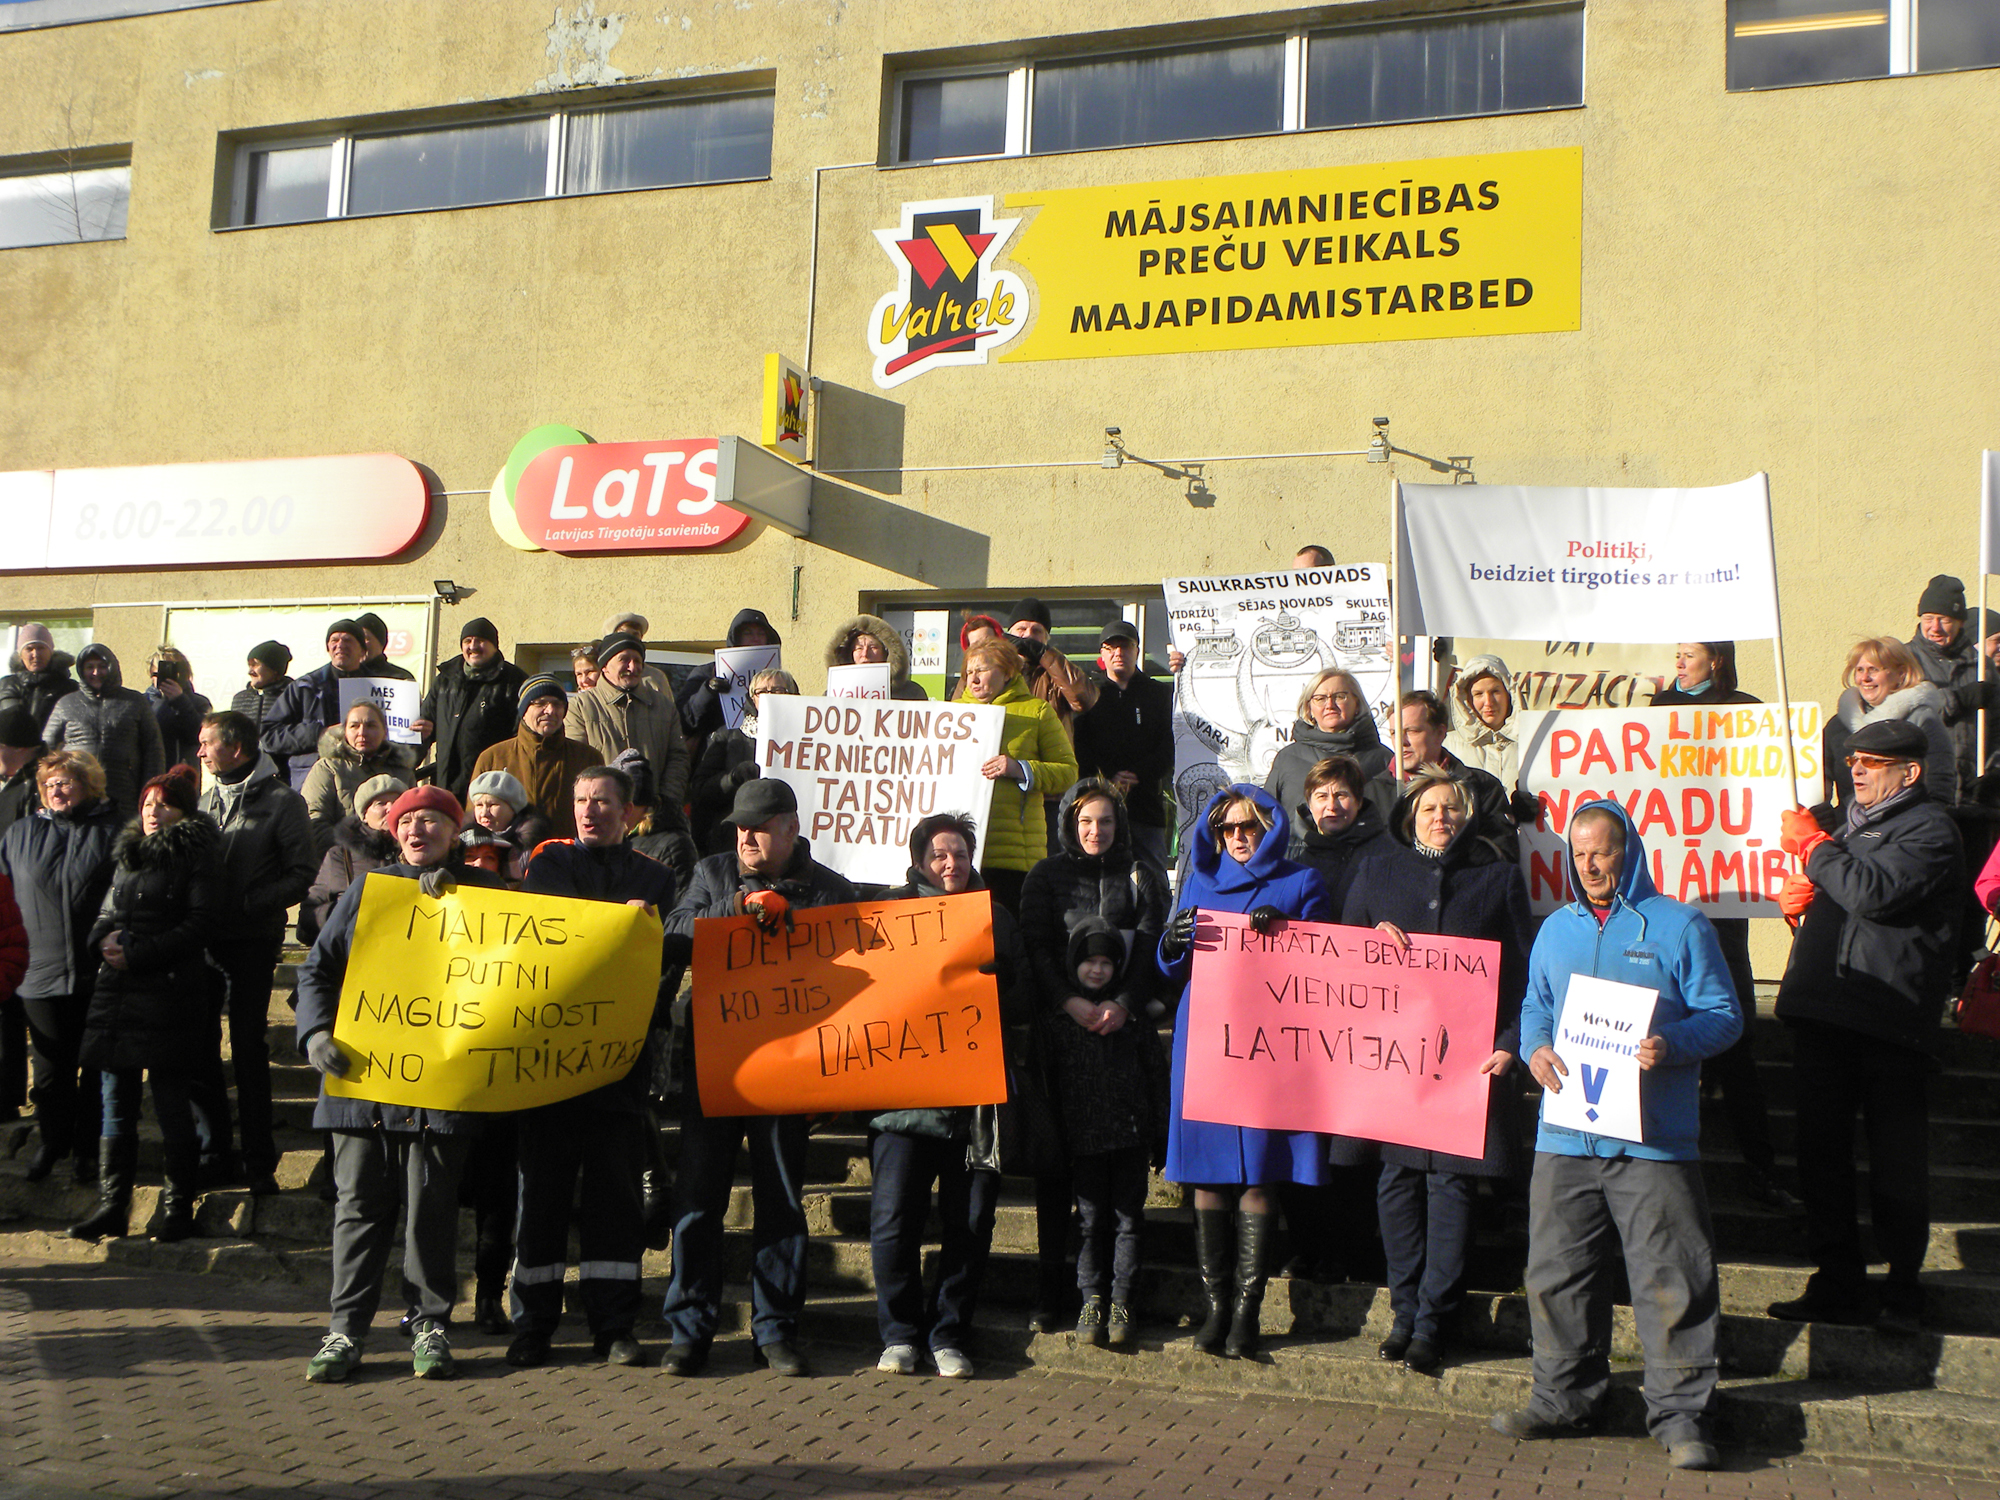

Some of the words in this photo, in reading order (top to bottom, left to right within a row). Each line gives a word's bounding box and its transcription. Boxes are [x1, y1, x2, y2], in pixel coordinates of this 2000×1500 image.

[1104, 179, 1500, 238] MĀJSAIMNIECĪBAS
[1139, 235, 1267, 277] PREČU
[1282, 228, 1460, 267] VEIKALS
[1069, 277, 1534, 333] MAJAPIDAMISTARBED
[550, 449, 719, 519] LaTS
[75, 494, 294, 540] 8.00-22.00
[545, 528, 594, 542] Latvijas
[598, 525, 654, 541] Tirgotāju
[657, 522, 719, 537] savienība
[1566, 540, 1653, 565] Politiķi,
[1178, 574, 1289, 593] SAULKRASTU
[1294, 567, 1371, 586] NOVADS
[1470, 563, 1555, 583] beidziet
[1561, 567, 1651, 590] tirgoties
[1657, 573, 1679, 585] ar
[1168, 607, 1215, 619] VIDRIŽU
[1237, 598, 1276, 612] SĒJAS
[1279, 596, 1334, 610] NOVADS
[1362, 612, 1390, 621] PAG.
[1179, 623, 1205, 632] PAG.
[385, 715, 410, 729] IERU
[1195, 717, 1230, 748] VARA
[1550, 722, 1657, 778] PAR
[811, 812, 923, 847] PRĀTU
[726, 901, 948, 971] DEPUTĀTI
[445, 956, 549, 990] PUTNI
[354, 990, 486, 1030] NAGUS
[513, 1000, 615, 1029] NOST
[719, 990, 761, 1023] KO
[772, 978, 831, 1016] JŪS
[816, 1005, 982, 1078] DARAT?
[367, 1050, 424, 1083] NO
